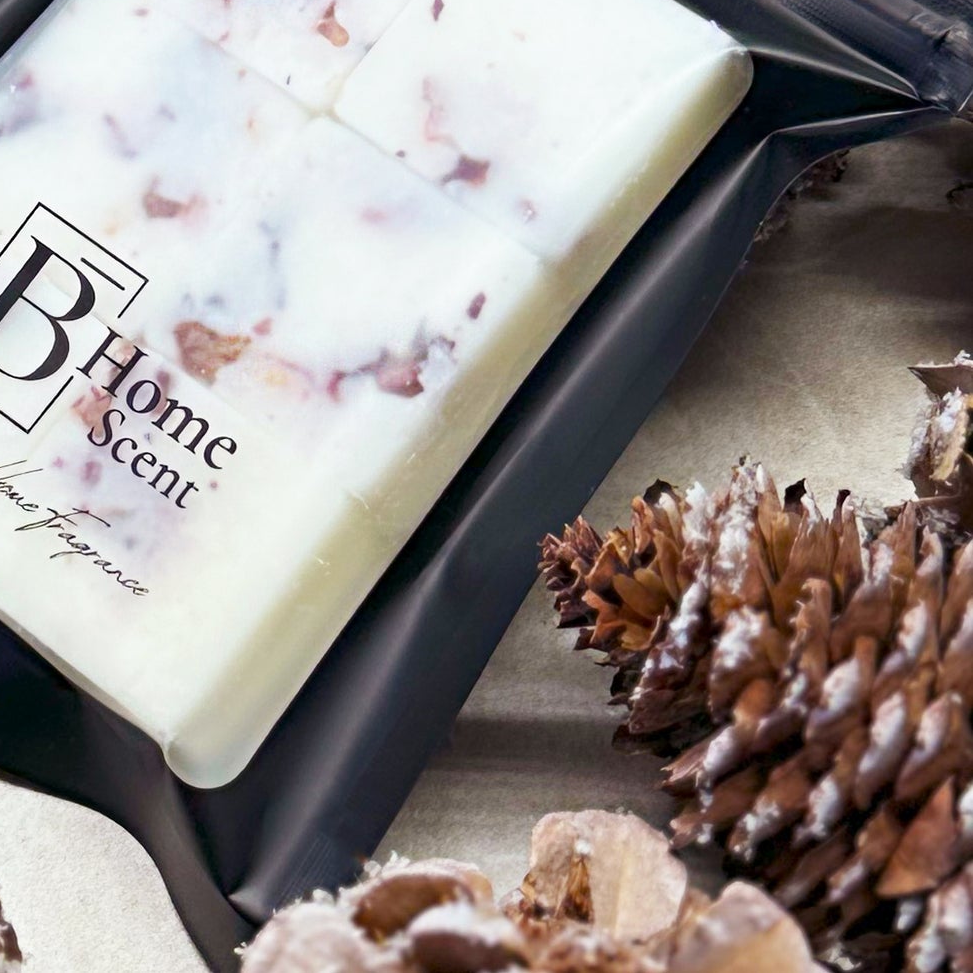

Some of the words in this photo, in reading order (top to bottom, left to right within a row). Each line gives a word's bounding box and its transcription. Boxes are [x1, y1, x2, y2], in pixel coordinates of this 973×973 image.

[76, 326, 238, 470] Home
[87, 409, 199, 509] Scent
[15, 508, 150, 597] Fragrance
